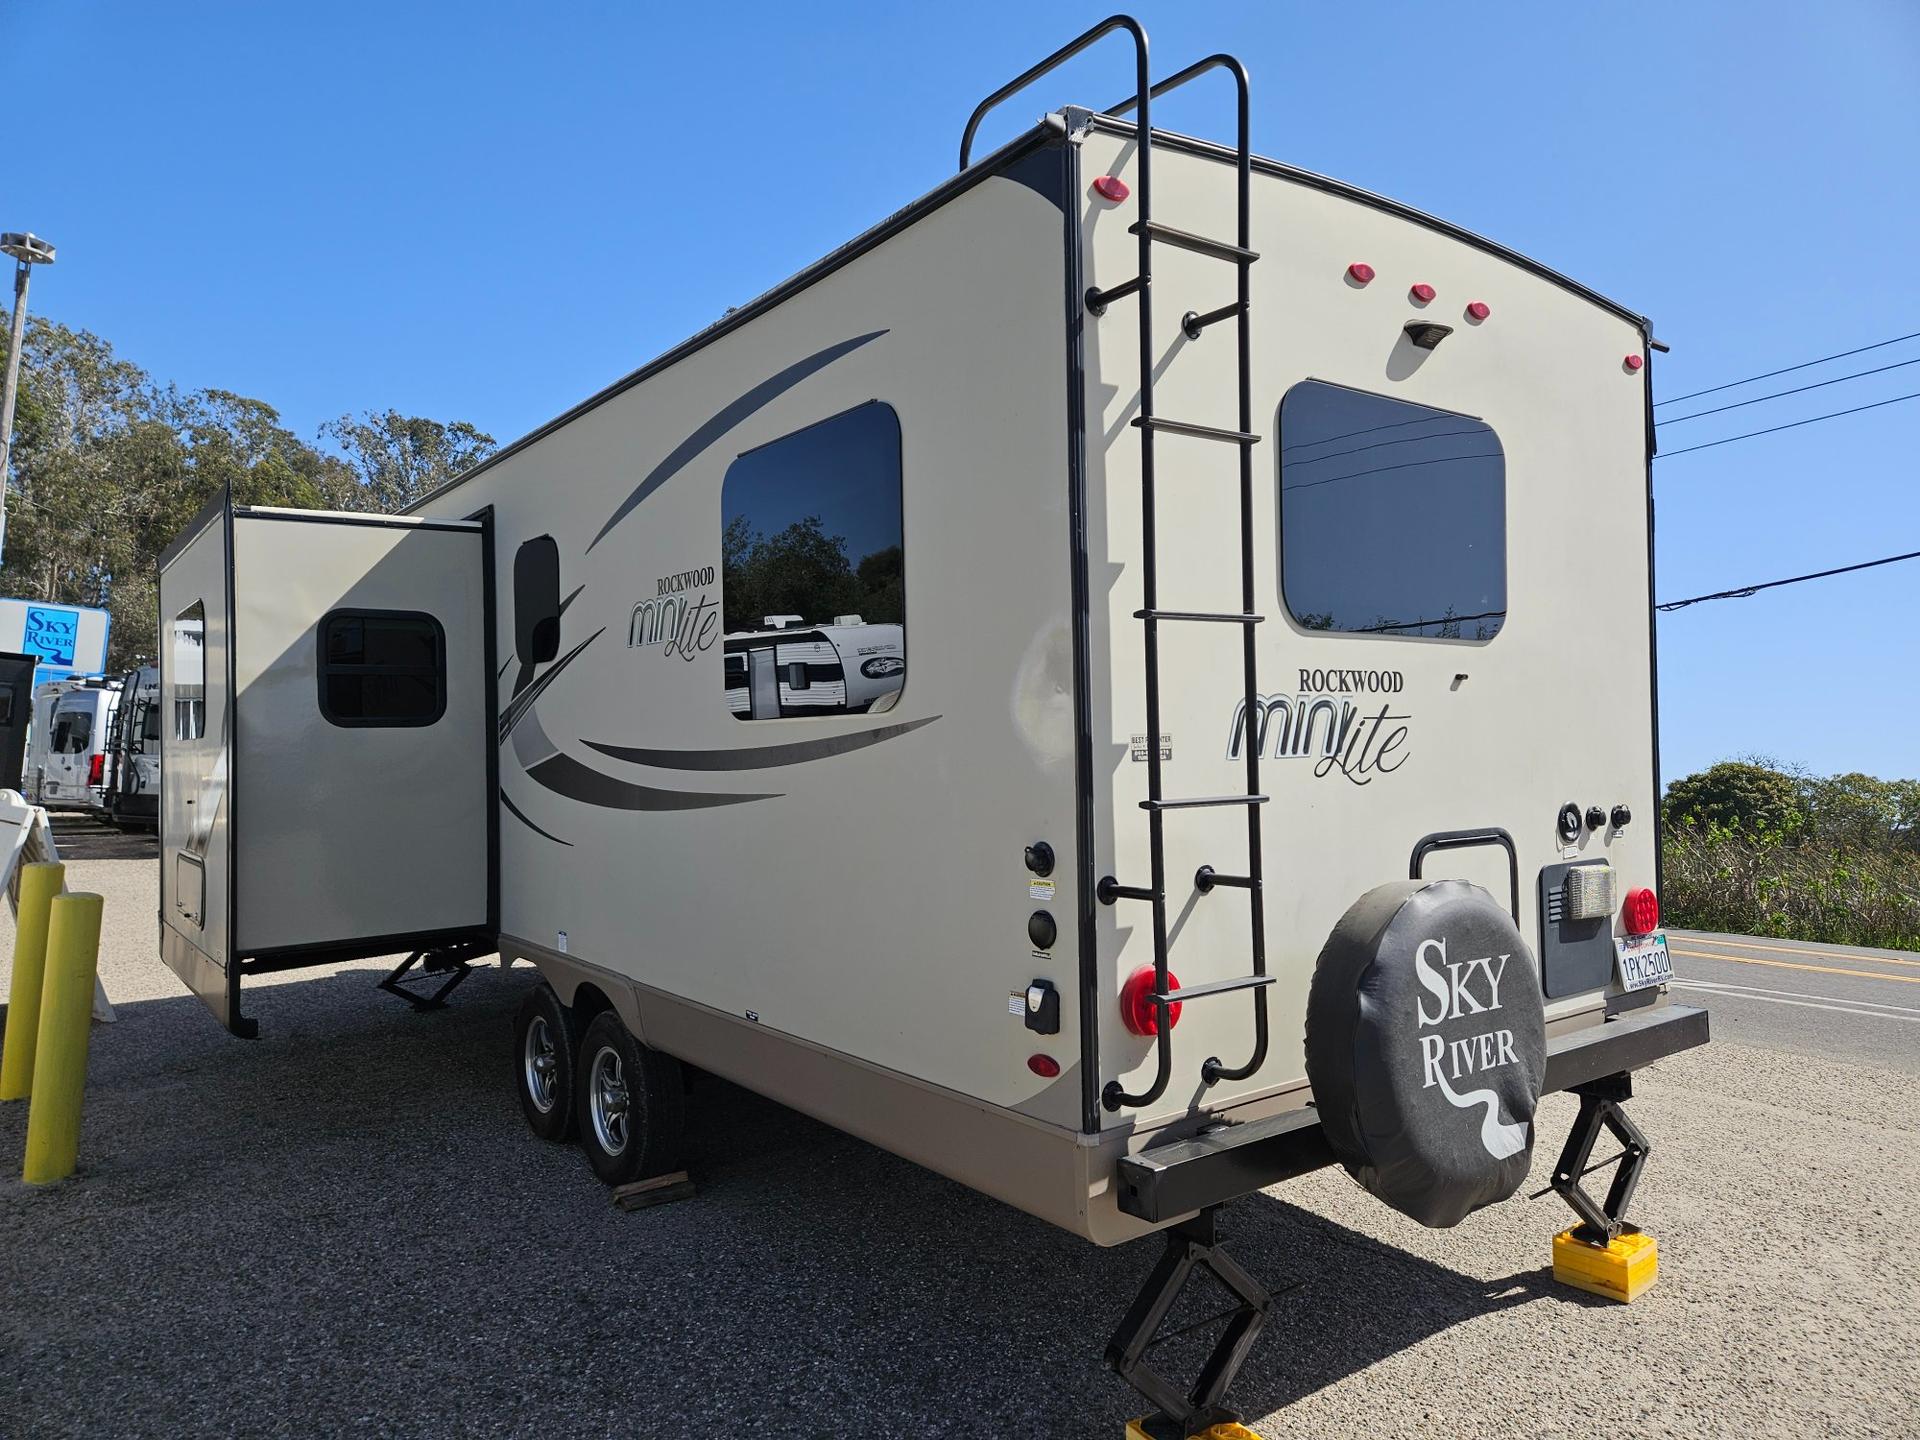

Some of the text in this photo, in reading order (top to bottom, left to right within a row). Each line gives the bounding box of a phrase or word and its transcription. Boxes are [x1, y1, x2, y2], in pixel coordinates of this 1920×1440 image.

[657, 566, 714, 596] ROCKWOOD
[28, 611, 75, 635] SKY
[664, 595, 720, 662] Lite
[26, 631, 73, 647] RIVER
[1299, 668, 1404, 693] ROCKWOOD
[1314, 703, 1412, 786] Lite
[1623, 951, 1669, 981] 1PK2500
[1415, 937, 1511, 1029] SKY
[1419, 1029, 1520, 1089] RIVER
